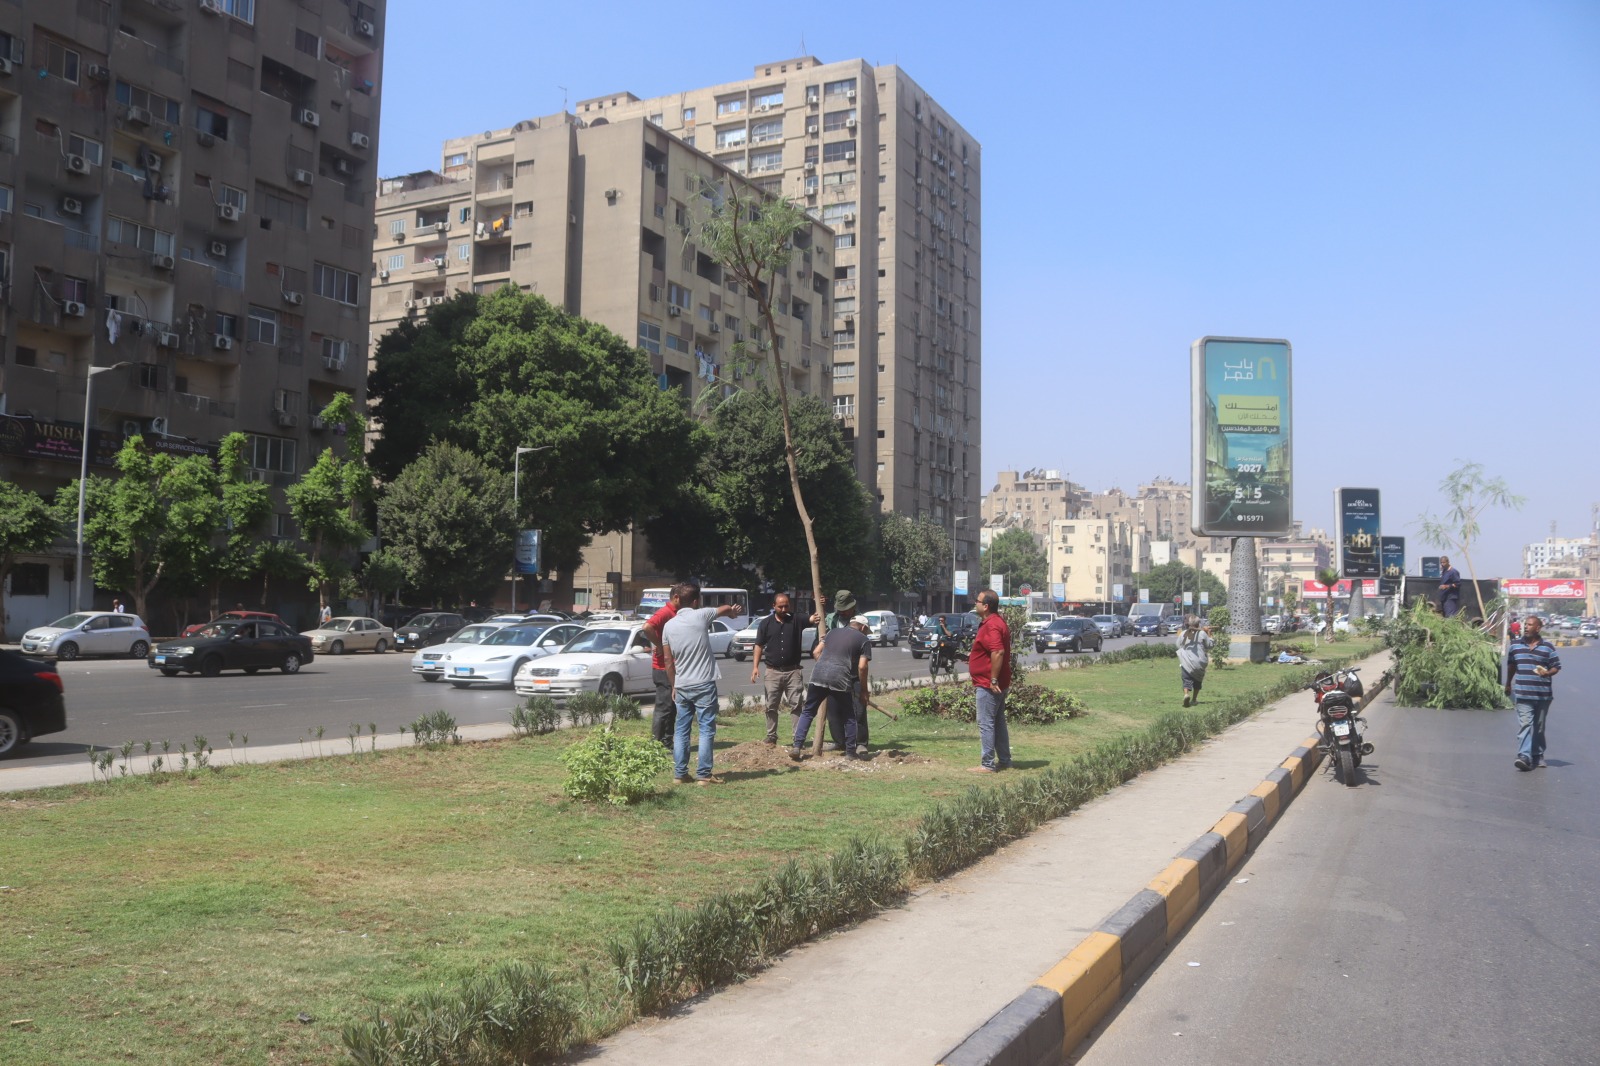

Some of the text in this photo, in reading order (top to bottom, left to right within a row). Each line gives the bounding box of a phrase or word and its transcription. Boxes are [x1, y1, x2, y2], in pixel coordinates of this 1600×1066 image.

[1224, 358, 1253, 371] باب
[1224, 371, 1253, 381] مصر
[34, 422, 83, 441] MISHA
[169, 443, 194, 451] SERVICES
[1237, 464, 1262, 473] 2027
